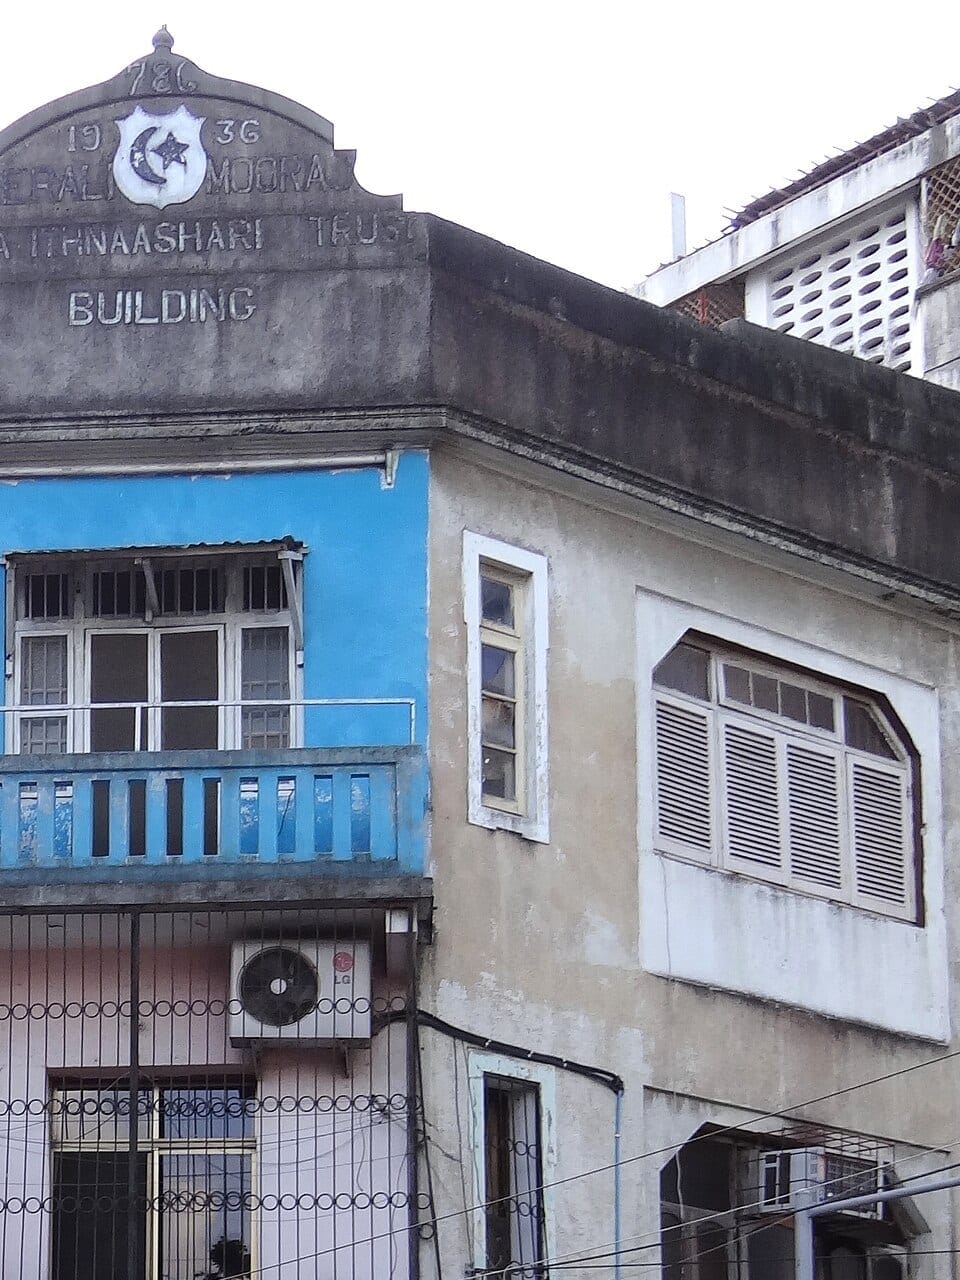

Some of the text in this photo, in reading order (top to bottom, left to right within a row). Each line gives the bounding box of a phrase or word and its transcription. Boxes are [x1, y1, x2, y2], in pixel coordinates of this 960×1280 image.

[69, 119, 260, 152] 19 36
[69, 287, 257, 326] BUILDING
[334, 975, 351, 985] LG
